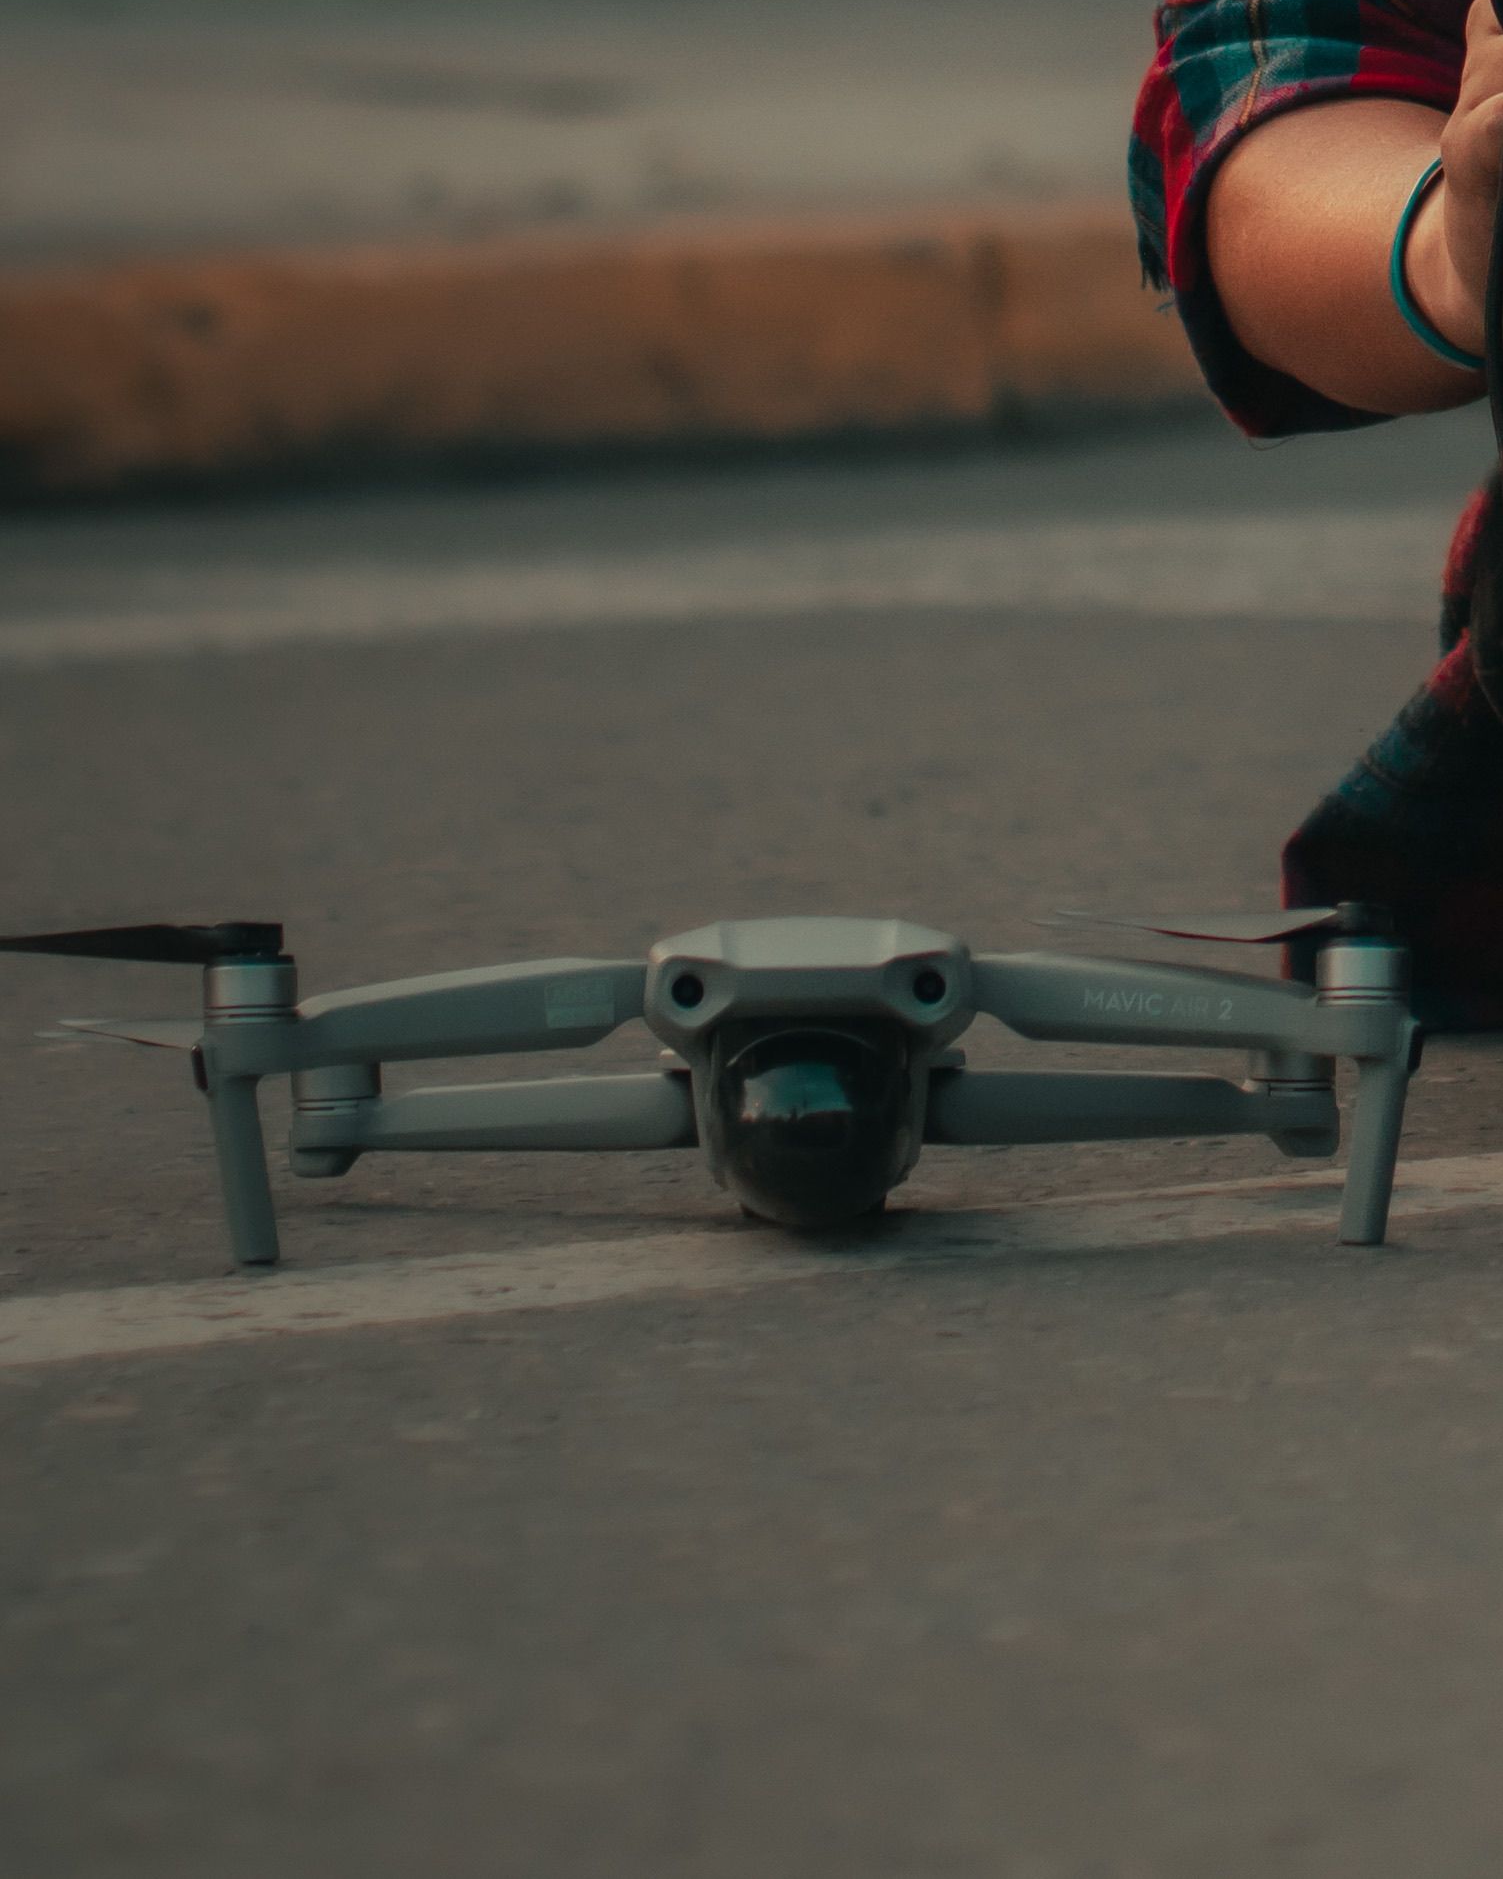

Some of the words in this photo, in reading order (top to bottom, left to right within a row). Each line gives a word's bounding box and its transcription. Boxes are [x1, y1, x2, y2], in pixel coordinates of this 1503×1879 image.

[1082, 985, 1164, 1016] MAVIC
[1170, 994, 1209, 1019] AIR
[1217, 999, 1233, 1020] 2
